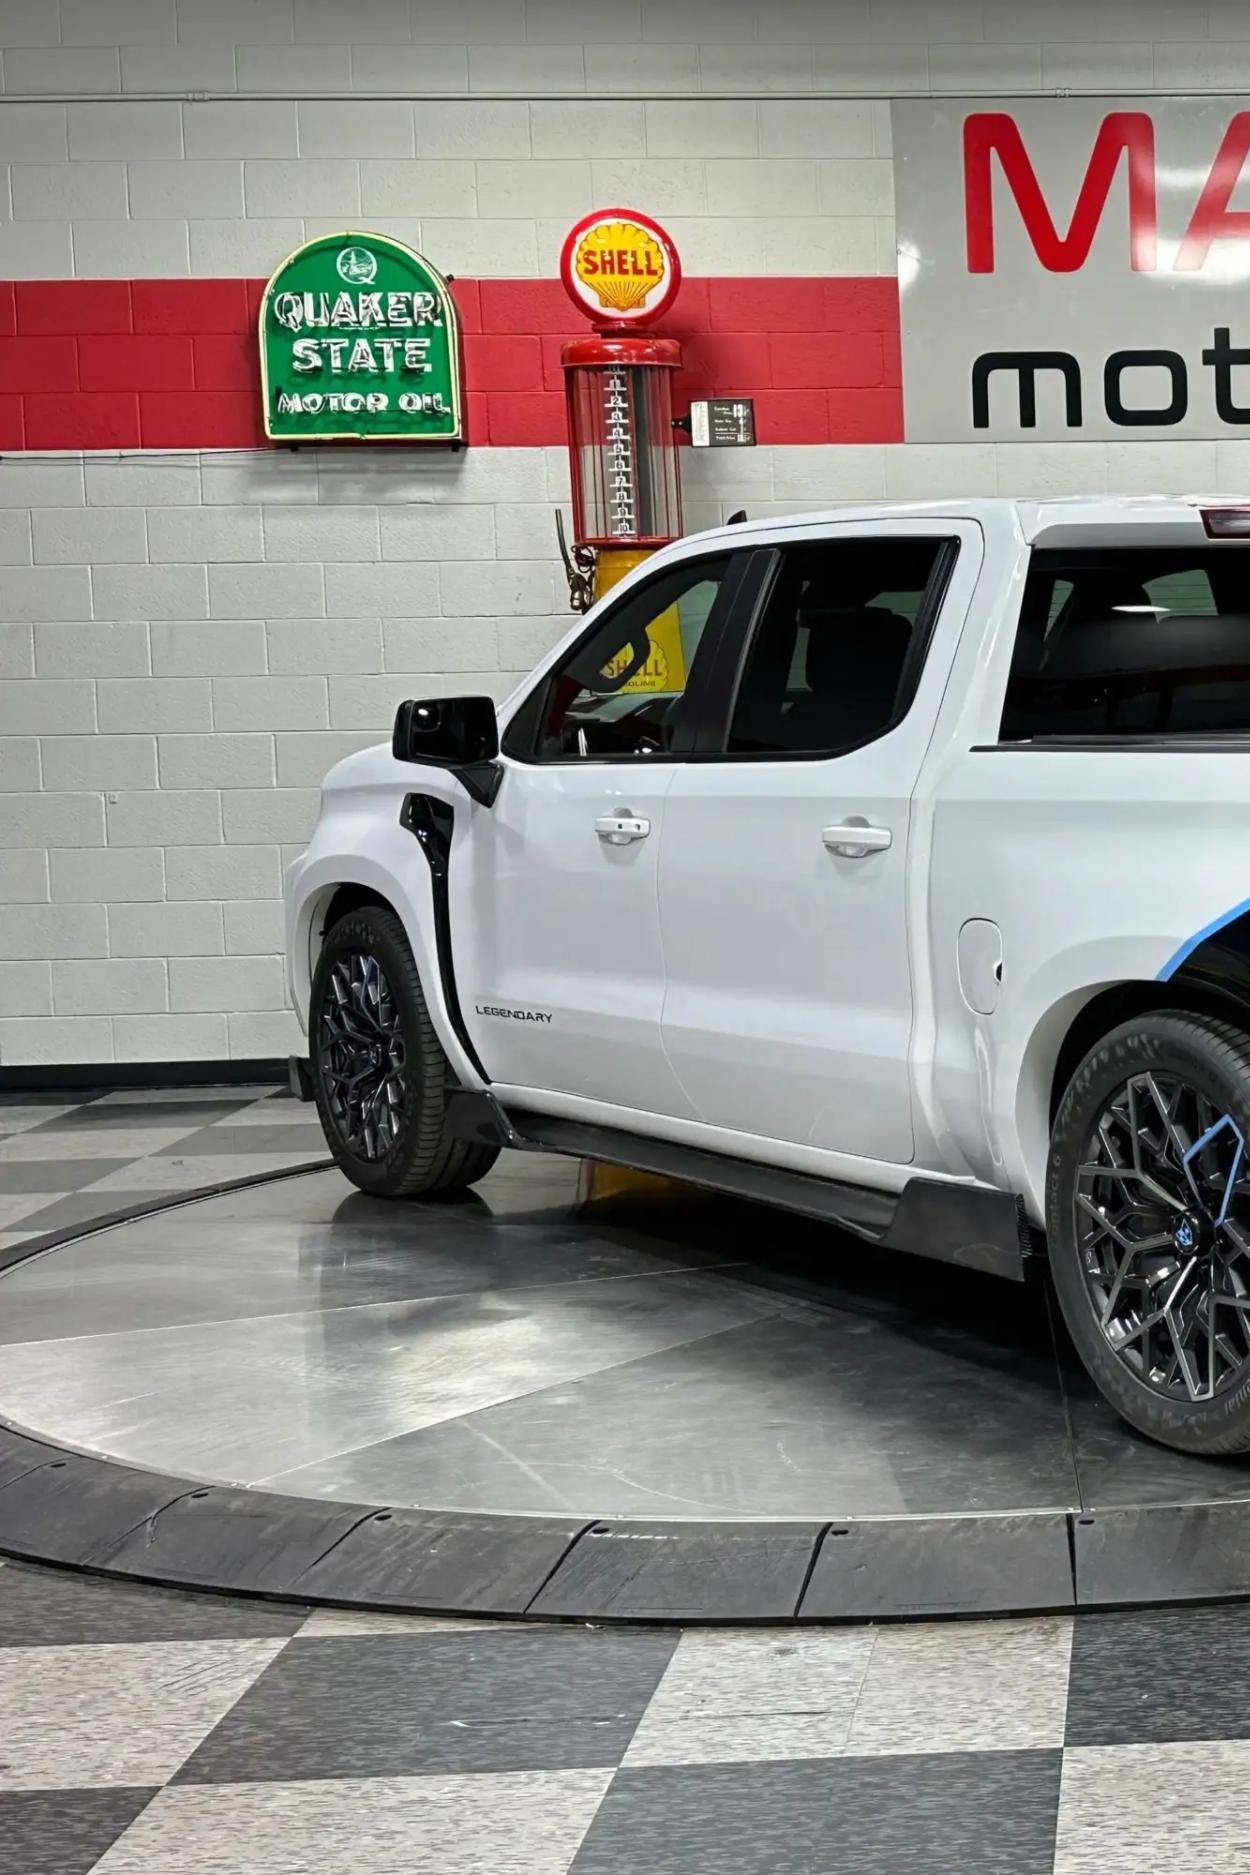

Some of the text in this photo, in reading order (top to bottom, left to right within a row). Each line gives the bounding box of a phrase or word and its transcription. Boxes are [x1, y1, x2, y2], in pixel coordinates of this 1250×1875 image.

[583, 249, 658, 276] SHELL
[274, 290, 443, 333] QUAKER
[292, 337, 433, 374] STATE
[277, 392, 451, 415] MOTOR OIL
[608, 659, 662, 676] SHLL
[475, 1005, 553, 1024] LEGENDARY
